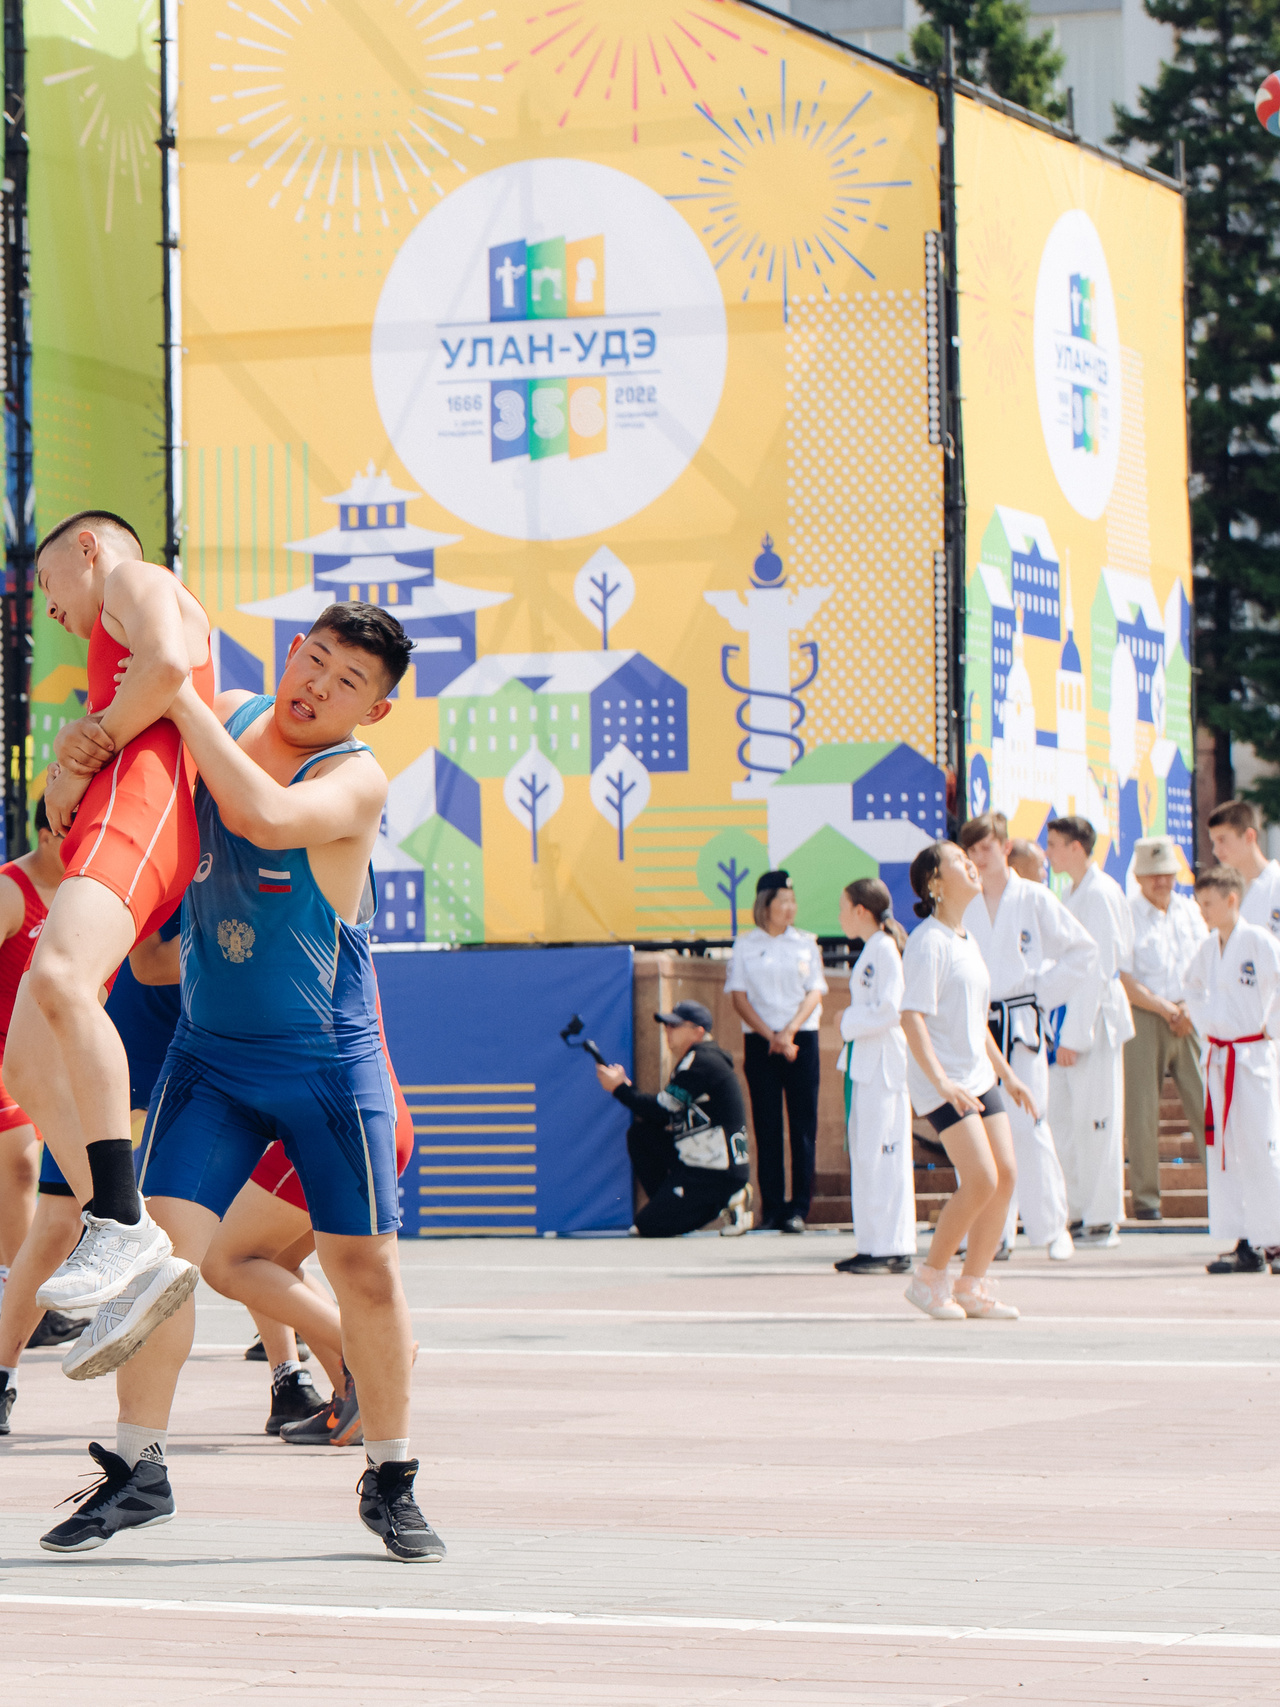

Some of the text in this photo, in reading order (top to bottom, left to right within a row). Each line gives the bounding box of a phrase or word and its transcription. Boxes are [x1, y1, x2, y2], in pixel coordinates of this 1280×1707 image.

[440, 327, 657, 369] УЛАН-УДЭ
[447, 394, 483, 412] 1666
[614, 385, 658, 405] 2022
[492, 386, 606, 442] 356
[140, 1452, 164, 1463] adida
